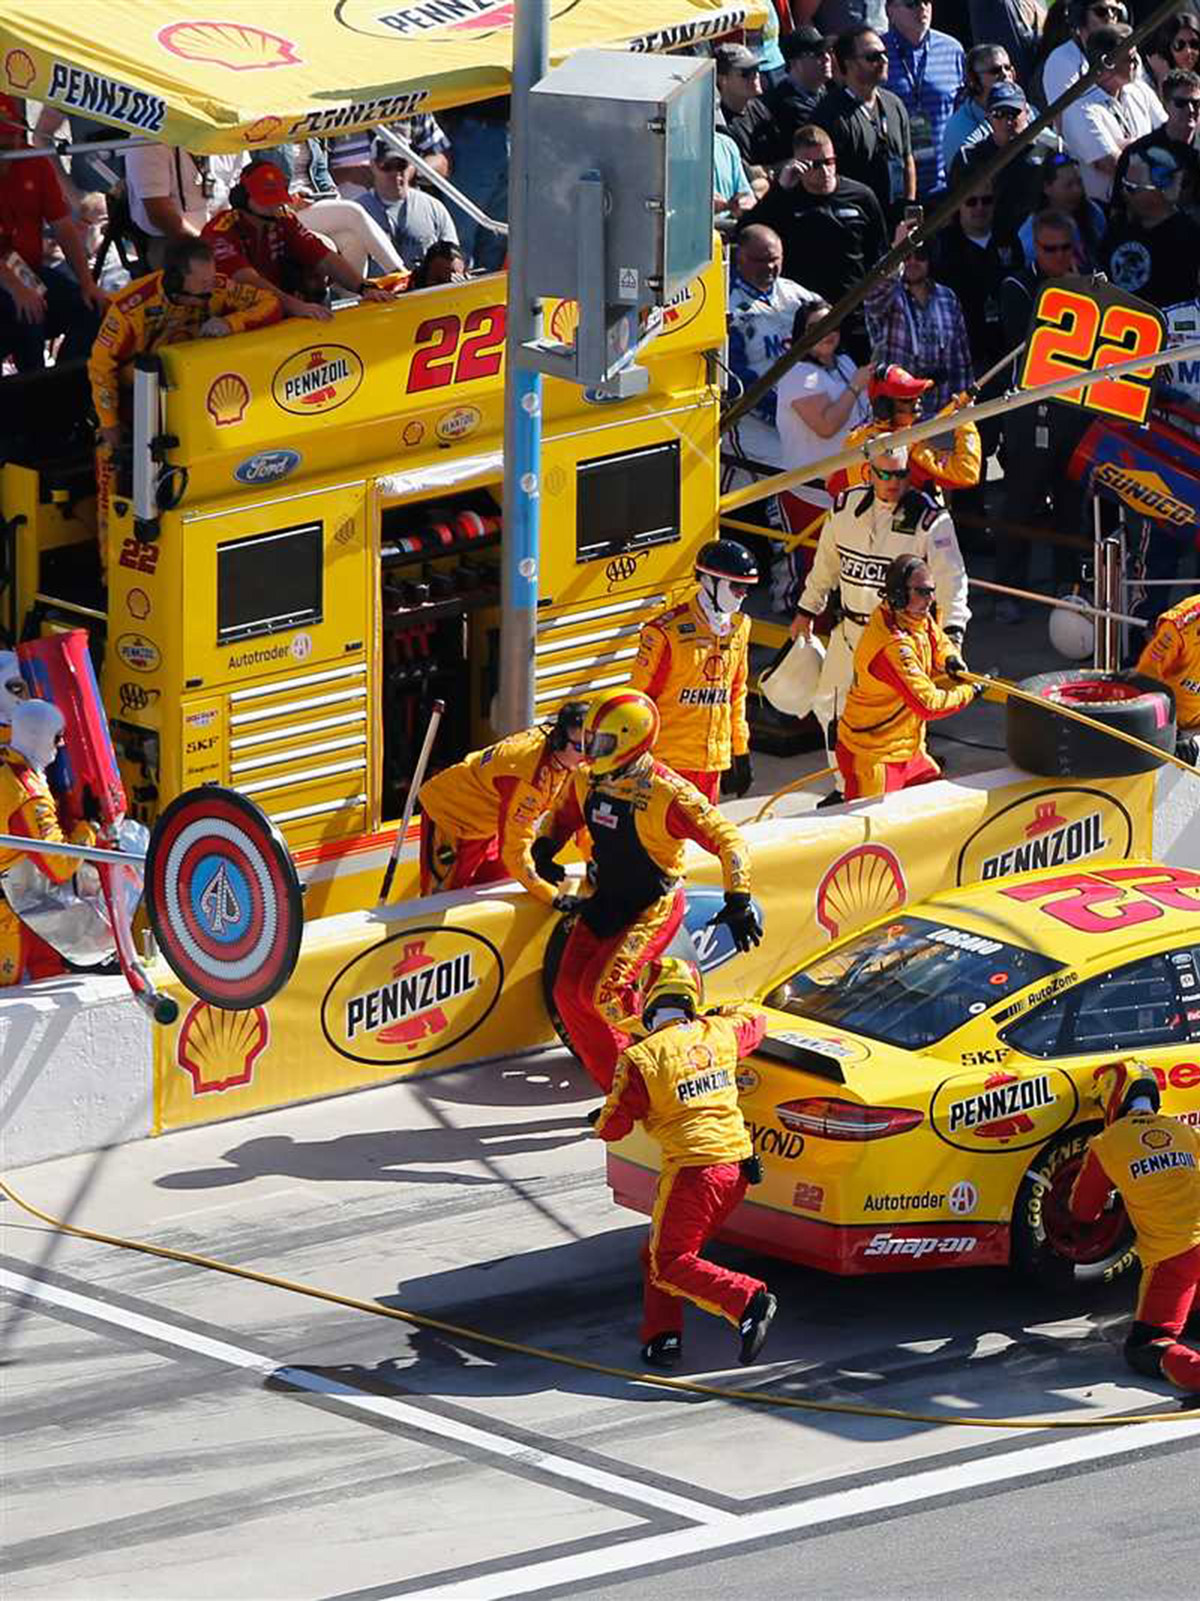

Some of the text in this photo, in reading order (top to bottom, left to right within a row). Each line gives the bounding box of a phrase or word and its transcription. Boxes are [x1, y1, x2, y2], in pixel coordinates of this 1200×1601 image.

[48, 63, 168, 132] PENNZOIL
[406, 304, 506, 394] 22
[1021, 288, 1163, 423] 22
[285, 358, 349, 400] PENNZOIL
[244, 455, 290, 480] Ford
[1100, 463, 1199, 526] SUNOCO
[119, 537, 160, 576] 22
[841, 557, 887, 582] OFFICI
[228, 644, 289, 670] Autotrader
[186, 735, 219, 754] SKF
[982, 814, 1106, 881] PENNZOIL
[346, 954, 476, 1038] PENNZOIL
[1028, 971, 1079, 1007] AutoZone
[961, 1048, 1010, 1066] SKF
[678, 1069, 732, 1101] PENNZOIL
[949, 1076, 1054, 1131] PENNZOIL
[745, 1119, 805, 1160] YOND
[1130, 1152, 1196, 1180] PENNZOIL
[792, 1182, 825, 1213] 22
[863, 1192, 946, 1211] Autotrader
[864, 1233, 977, 1258] Snap-on
